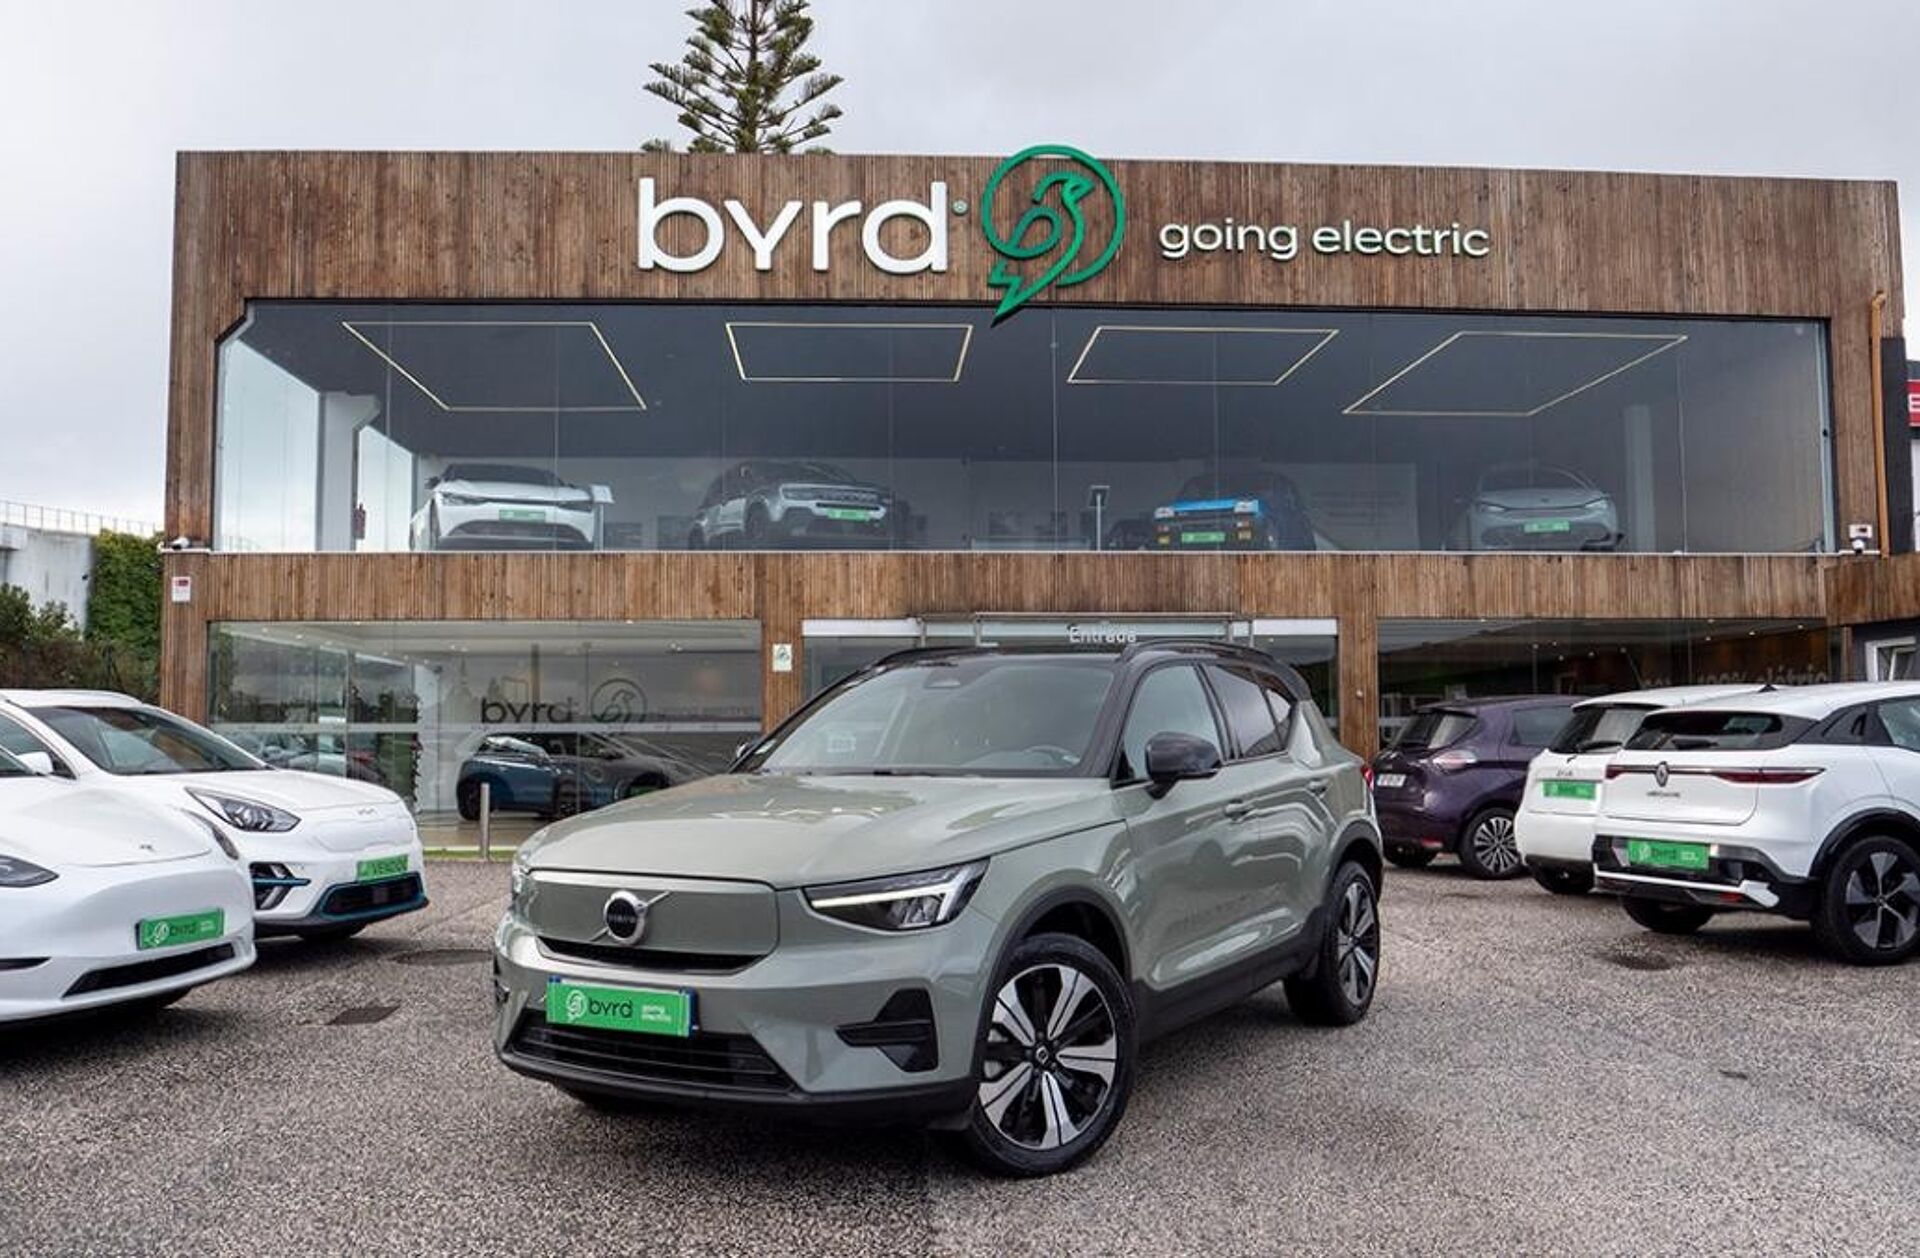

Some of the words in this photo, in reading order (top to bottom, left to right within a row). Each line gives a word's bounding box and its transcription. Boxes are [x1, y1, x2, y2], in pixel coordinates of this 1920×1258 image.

[638, 177, 948, 273] byrd
[1159, 217, 1298, 260] going
[1312, 219, 1490, 256] electric
[480, 697, 572, 724] byrd
[588, 998, 634, 1018] byrd
